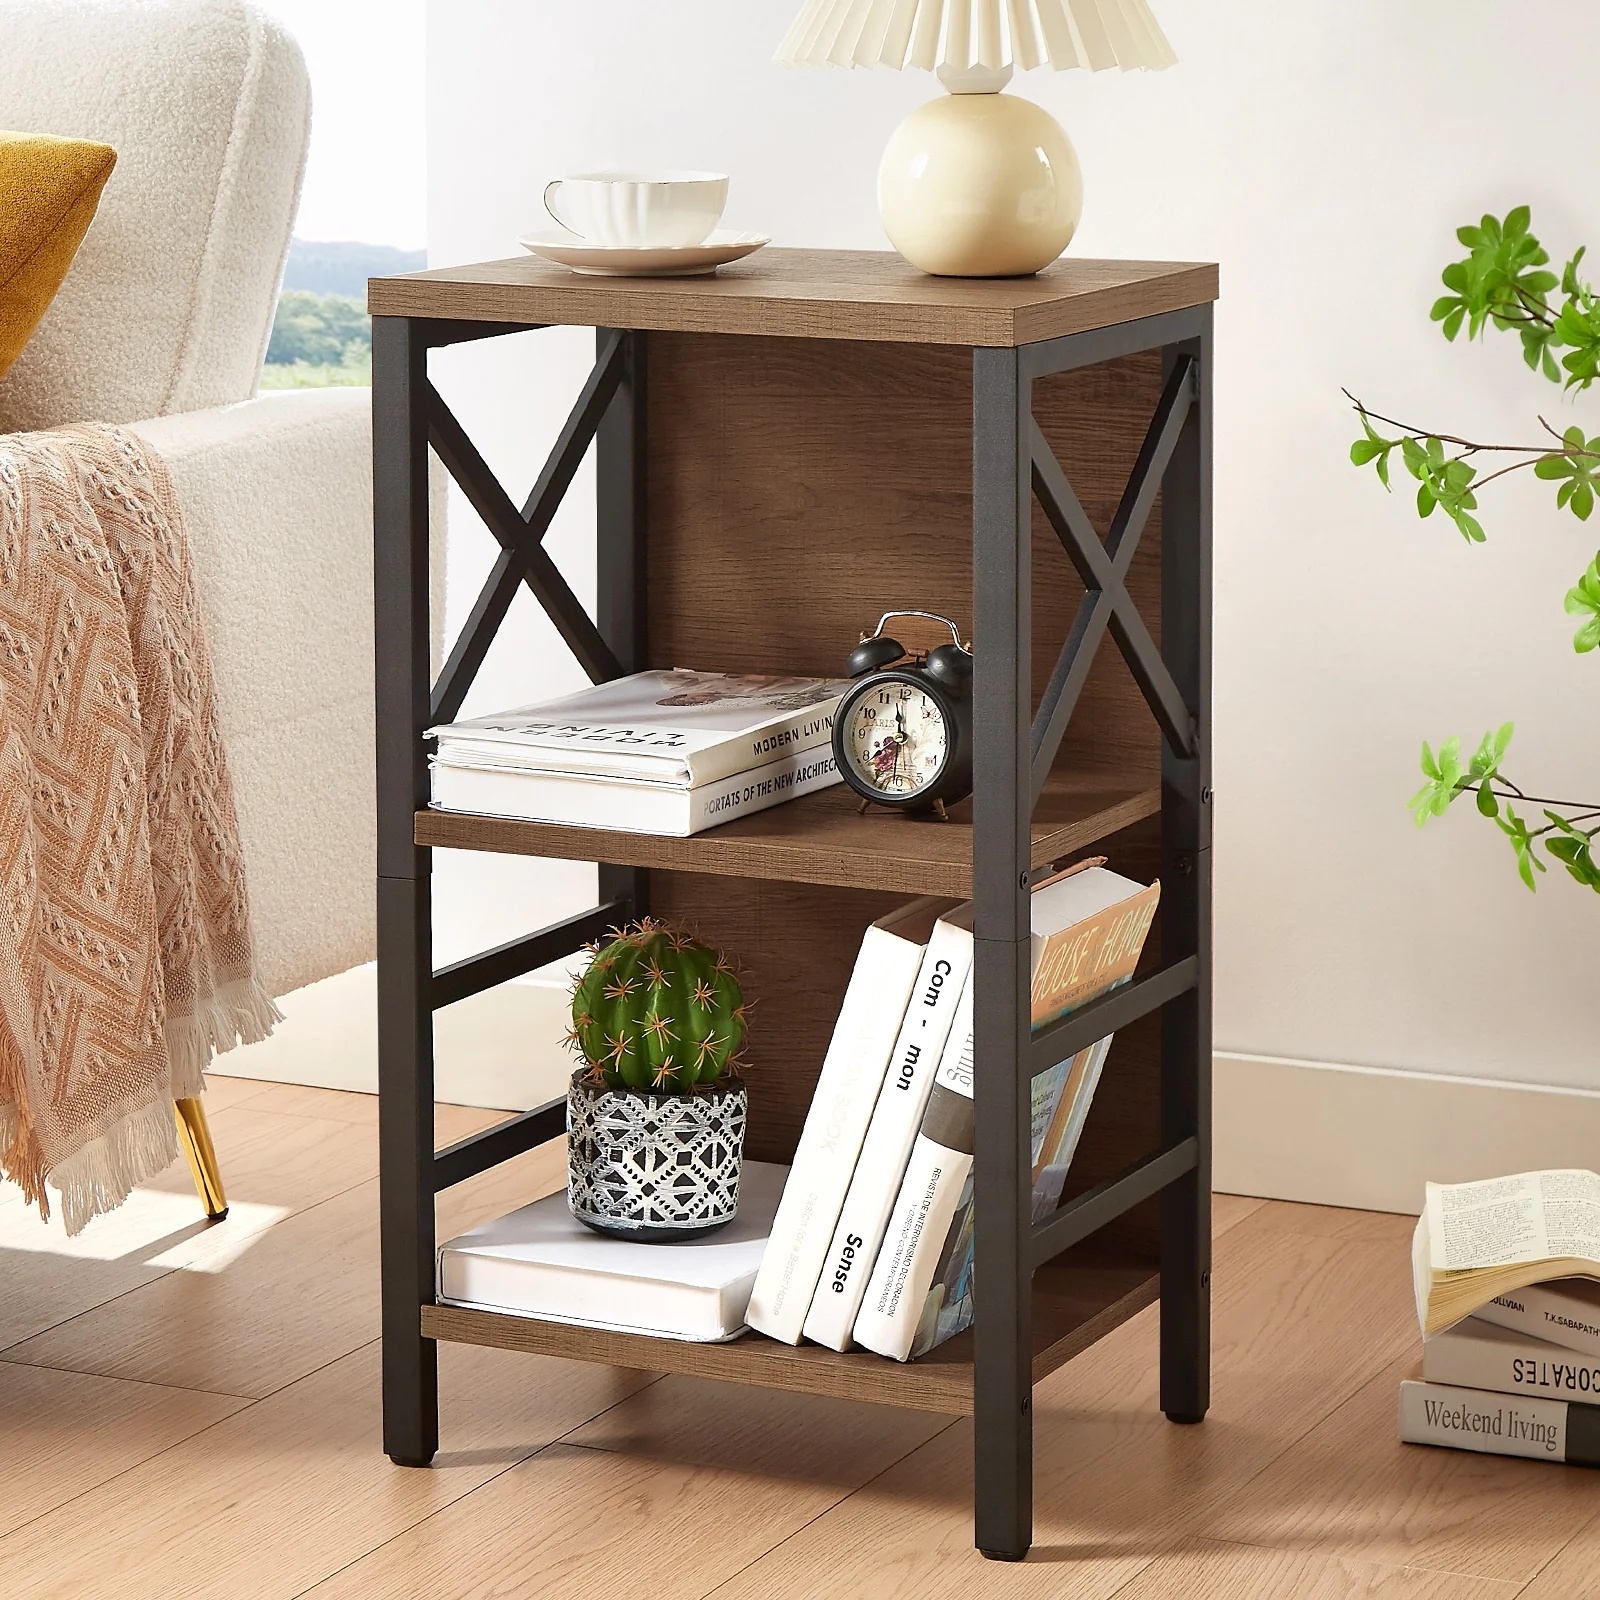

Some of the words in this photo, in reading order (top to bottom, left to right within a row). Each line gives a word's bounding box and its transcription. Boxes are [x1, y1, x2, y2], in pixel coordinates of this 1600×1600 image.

[879, 693, 890, 704] 11
[899, 688, 912, 700] 12
[863, 708, 876, 719] 10
[934, 713, 942, 723] 2
[484, 726, 686, 746] MODERN
[526, 723, 684, 739] LIVING
[753, 728, 799, 755] MODERN
[859, 728, 866, 739] 9
[862, 750, 870, 761] 8
[704, 790, 740, 816] PORTATS
[743, 786, 754, 802] OF
[757, 780, 772, 797] THE
[774, 772, 794, 791] NEW
[796, 757, 837, 784] ARCHITEC
[895, 776, 903, 787] 6
[923, 959, 952, 1007] Com
[896, 1044, 921, 1091] mon
[924, 1167, 942, 1199] REVISTA
[801, 1192, 819, 1227] Design
[920, 1200, 931, 1212] DE
[783, 1253, 799, 1285] Better
[832, 1233, 863, 1293] Sense
[773, 1284, 789, 1317] Home
[1544, 1311, 1600, 1337] T.K.SABAPATH
[1424, 1399, 1502, 1436] Weekend
[1508, 1410, 1558, 1452] living
